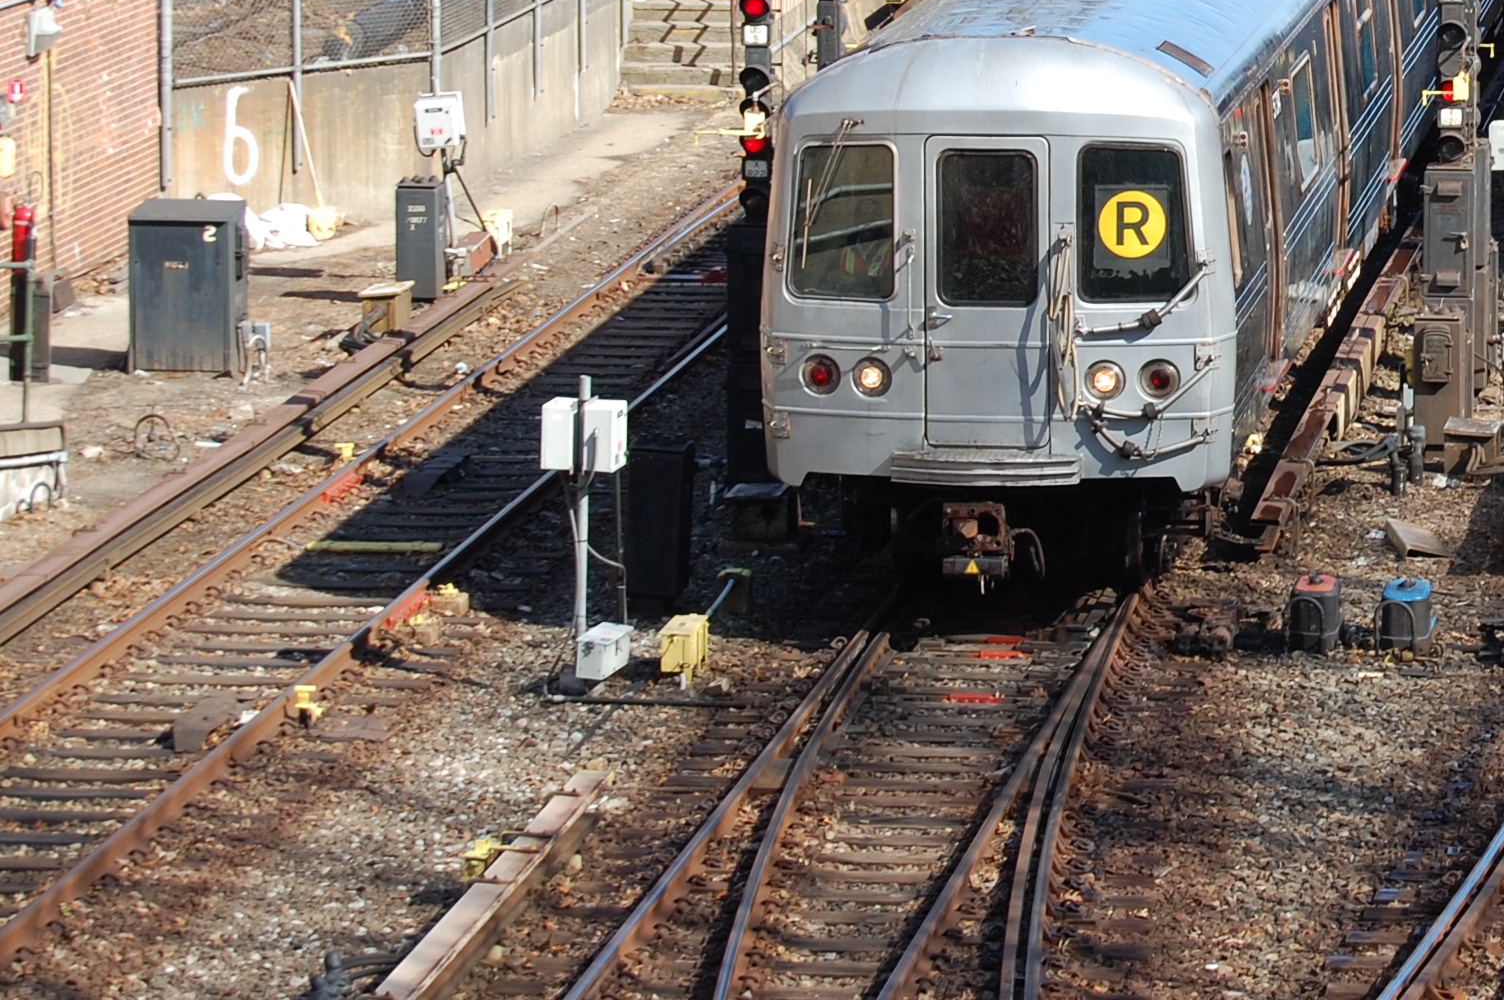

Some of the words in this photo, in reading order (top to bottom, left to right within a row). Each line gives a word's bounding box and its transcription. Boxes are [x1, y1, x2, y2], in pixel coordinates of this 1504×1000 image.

[224, 86, 259, 185] 6
[202, 225, 217, 243] 2
[1116, 201, 1149, 246] R
